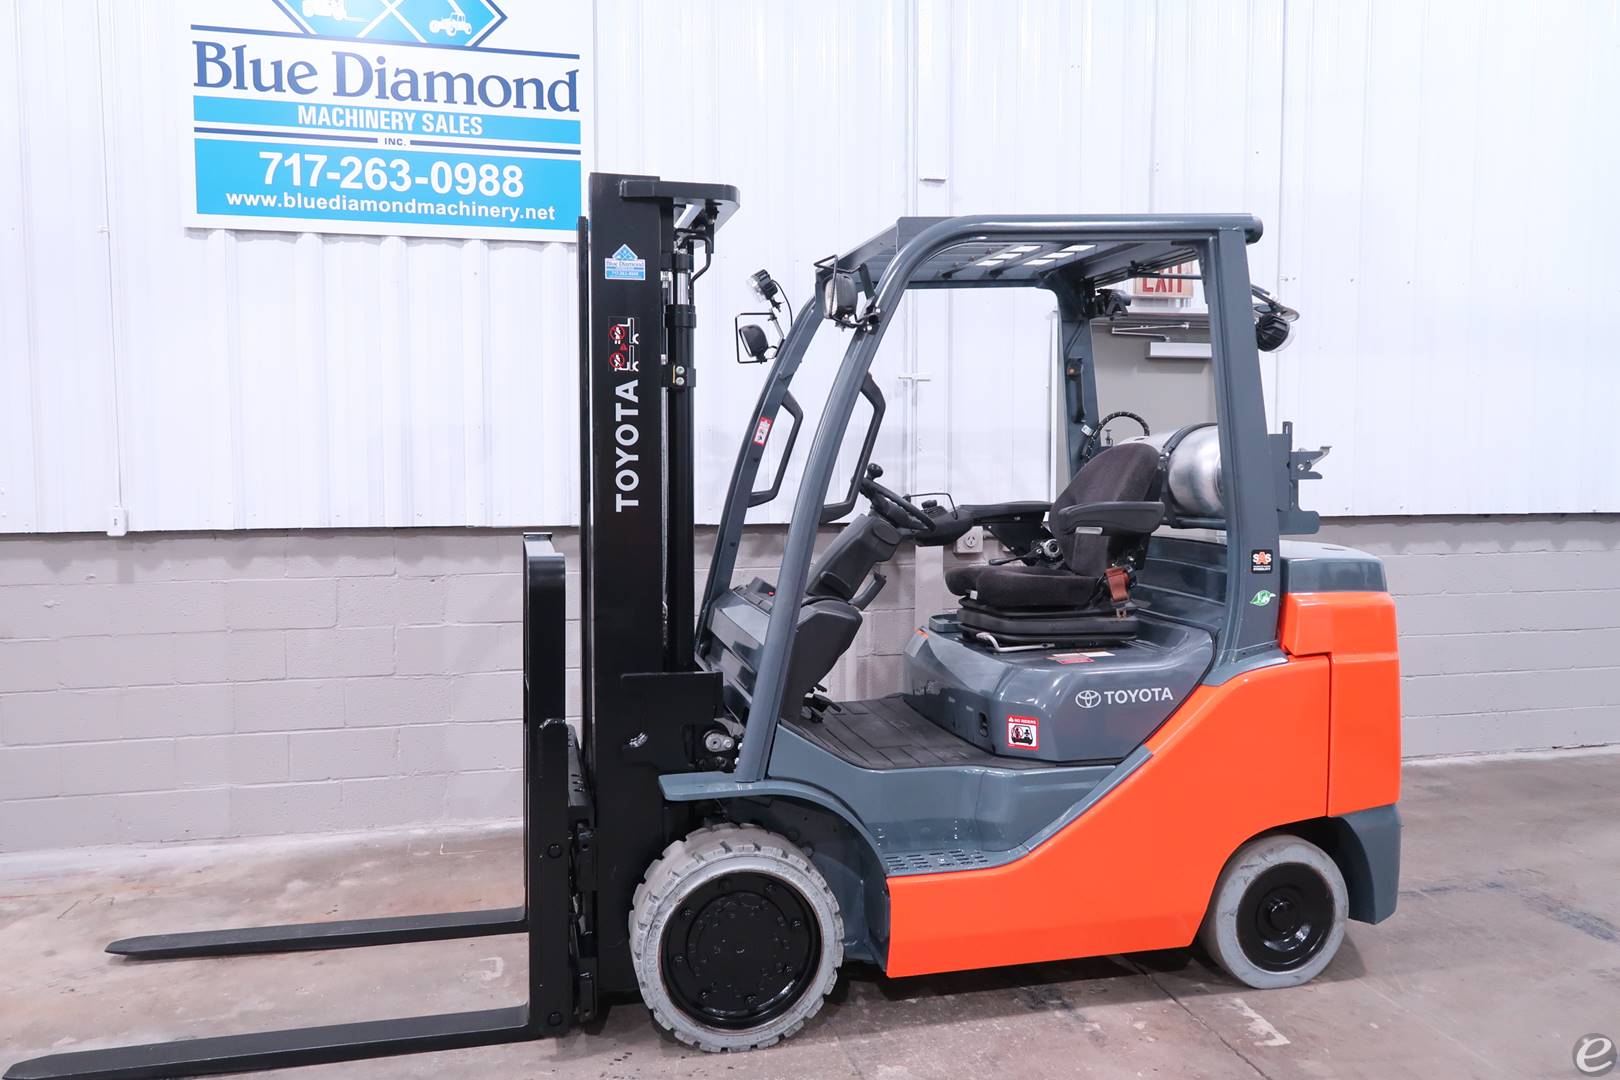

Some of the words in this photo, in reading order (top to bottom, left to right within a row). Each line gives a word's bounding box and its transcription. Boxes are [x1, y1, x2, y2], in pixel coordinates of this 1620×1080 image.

[192, 40, 318, 95] Blue
[331, 50, 580, 113] Diamond
[297, 104, 416, 131] MACHINERY
[422, 112, 483, 135] SALES
[384, 137, 407, 147] INC.
[258, 151, 524, 198] 717-263-0988
[226, 191, 556, 221] www.bluediamondmachinery.net
[615, 379, 640, 513] TOYOTA
[1252, 551, 1272, 565] SAS
[1104, 687, 1174, 705] TOYOTA
